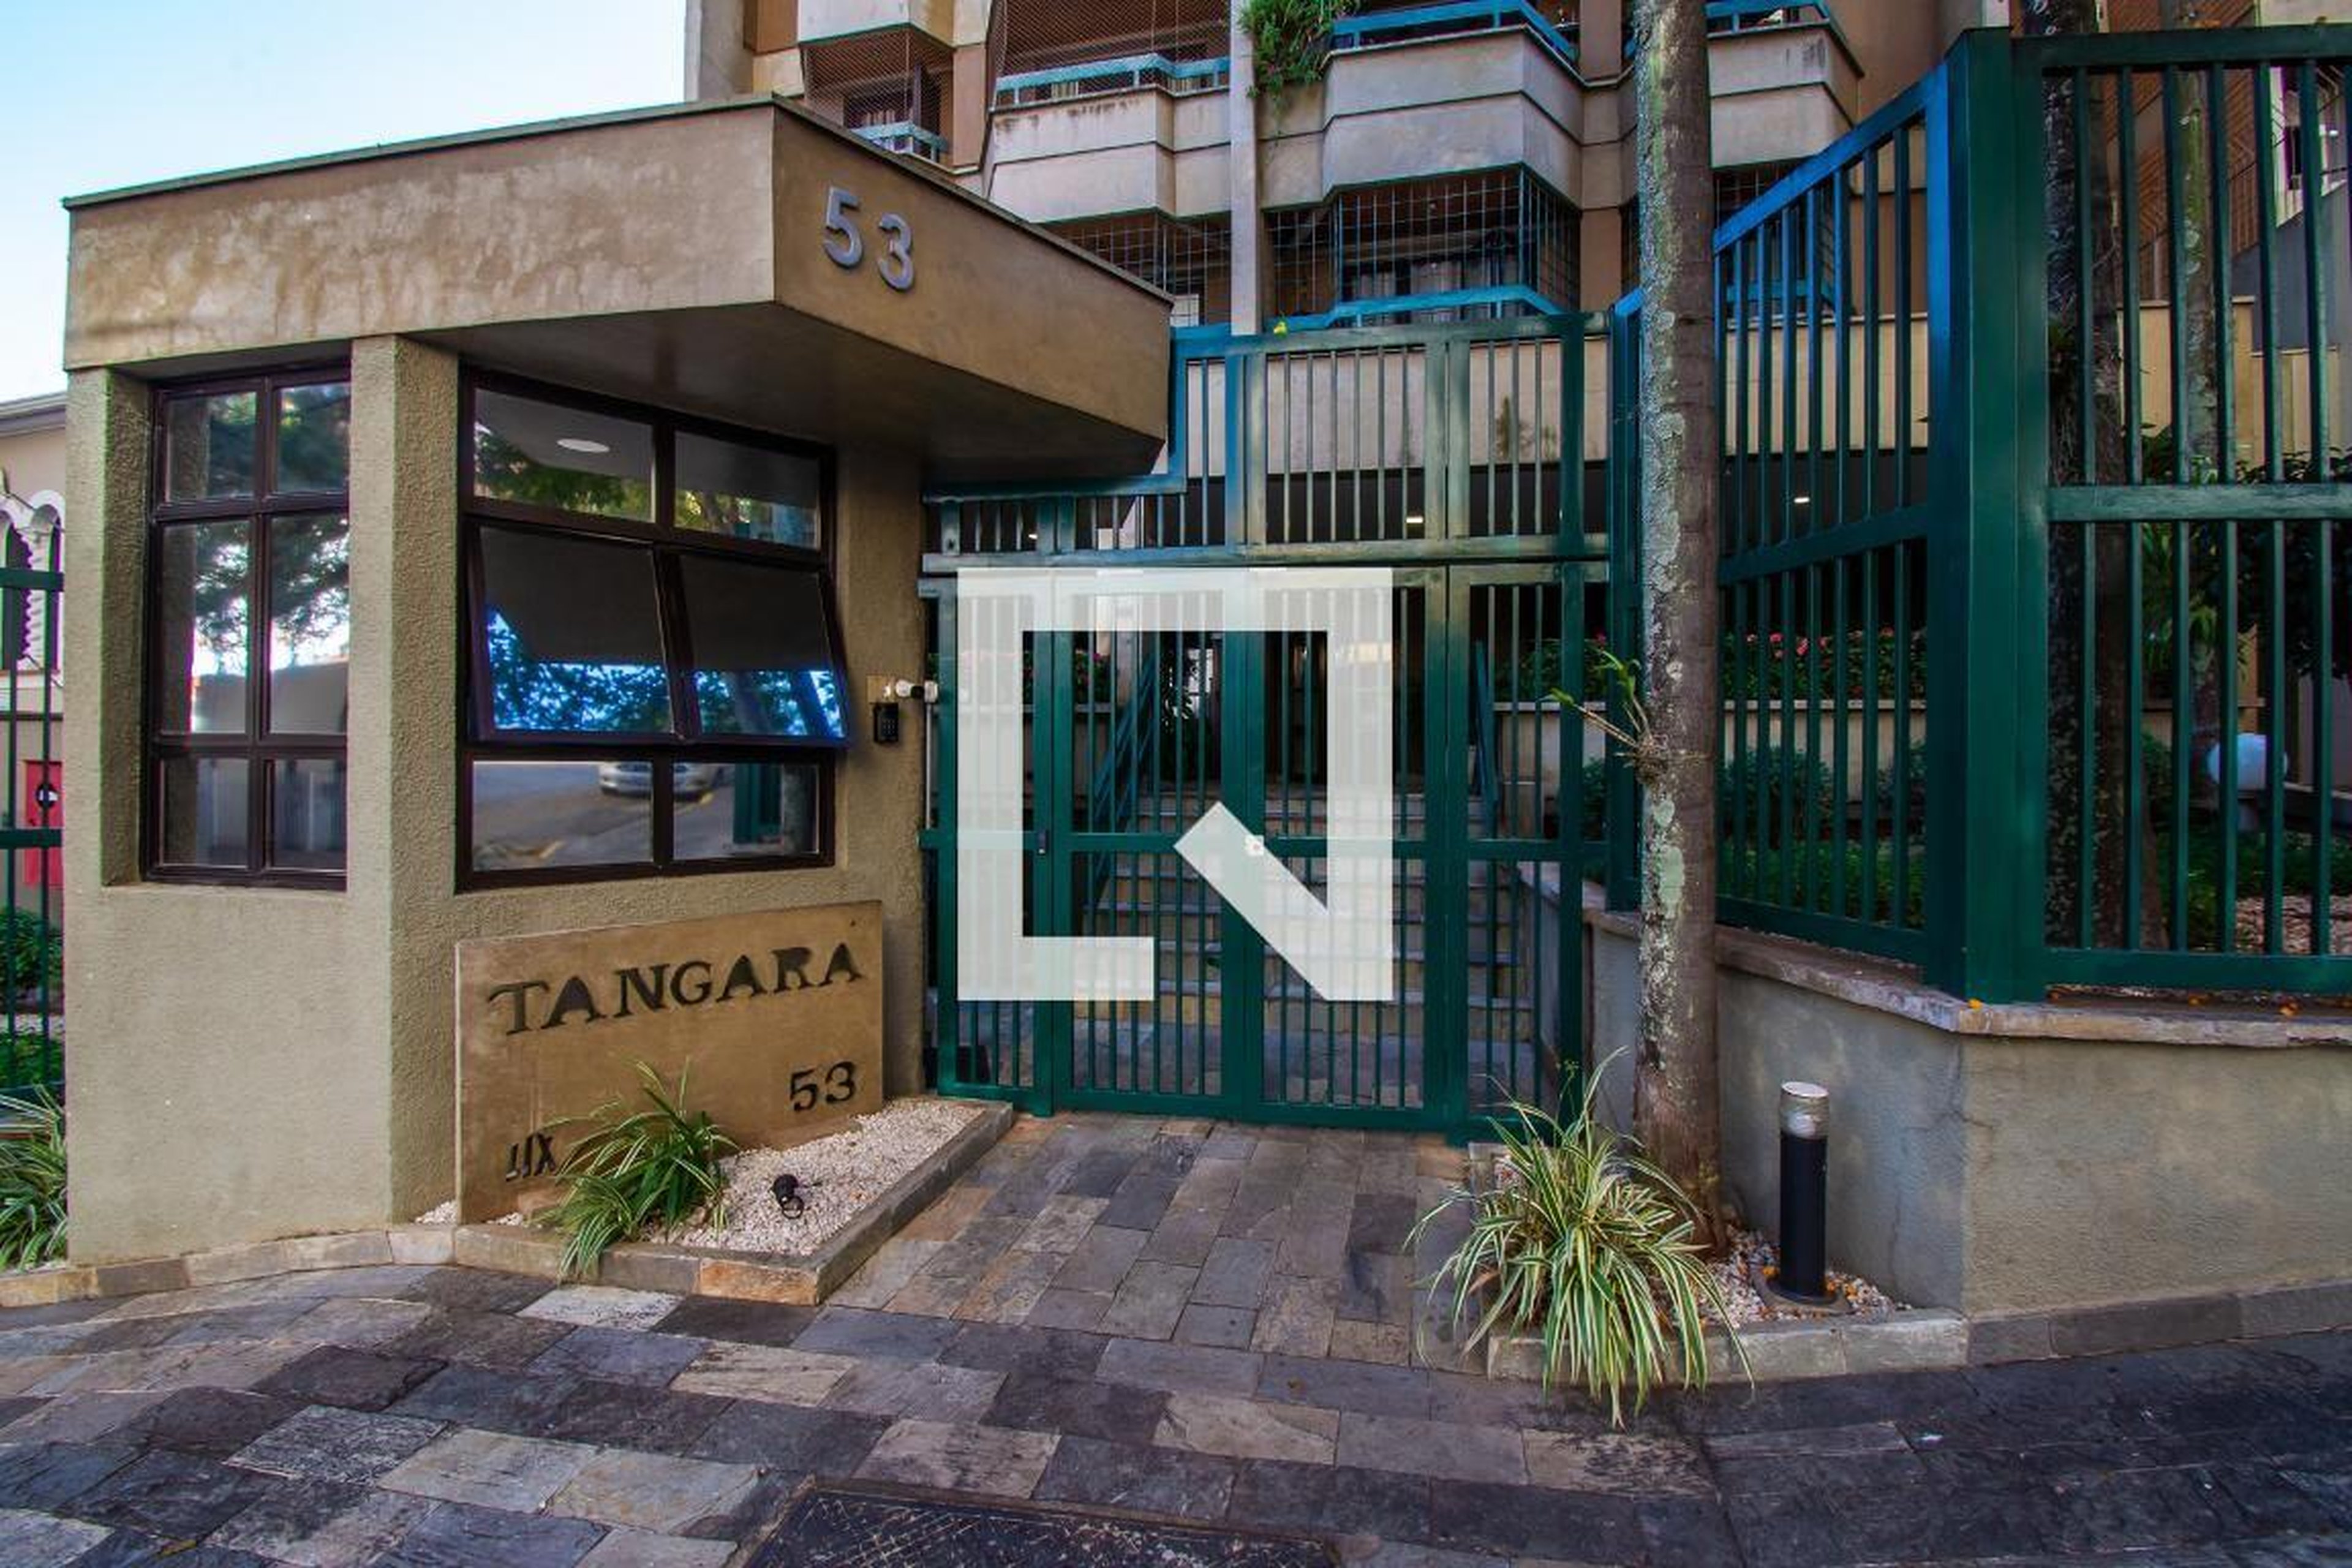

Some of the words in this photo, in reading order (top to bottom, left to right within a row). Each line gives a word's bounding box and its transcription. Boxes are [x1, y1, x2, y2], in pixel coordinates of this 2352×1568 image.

[823, 186, 914, 293] 53
[488, 943, 863, 1035] TANGARA
[790, 1061, 856, 1111] 53
